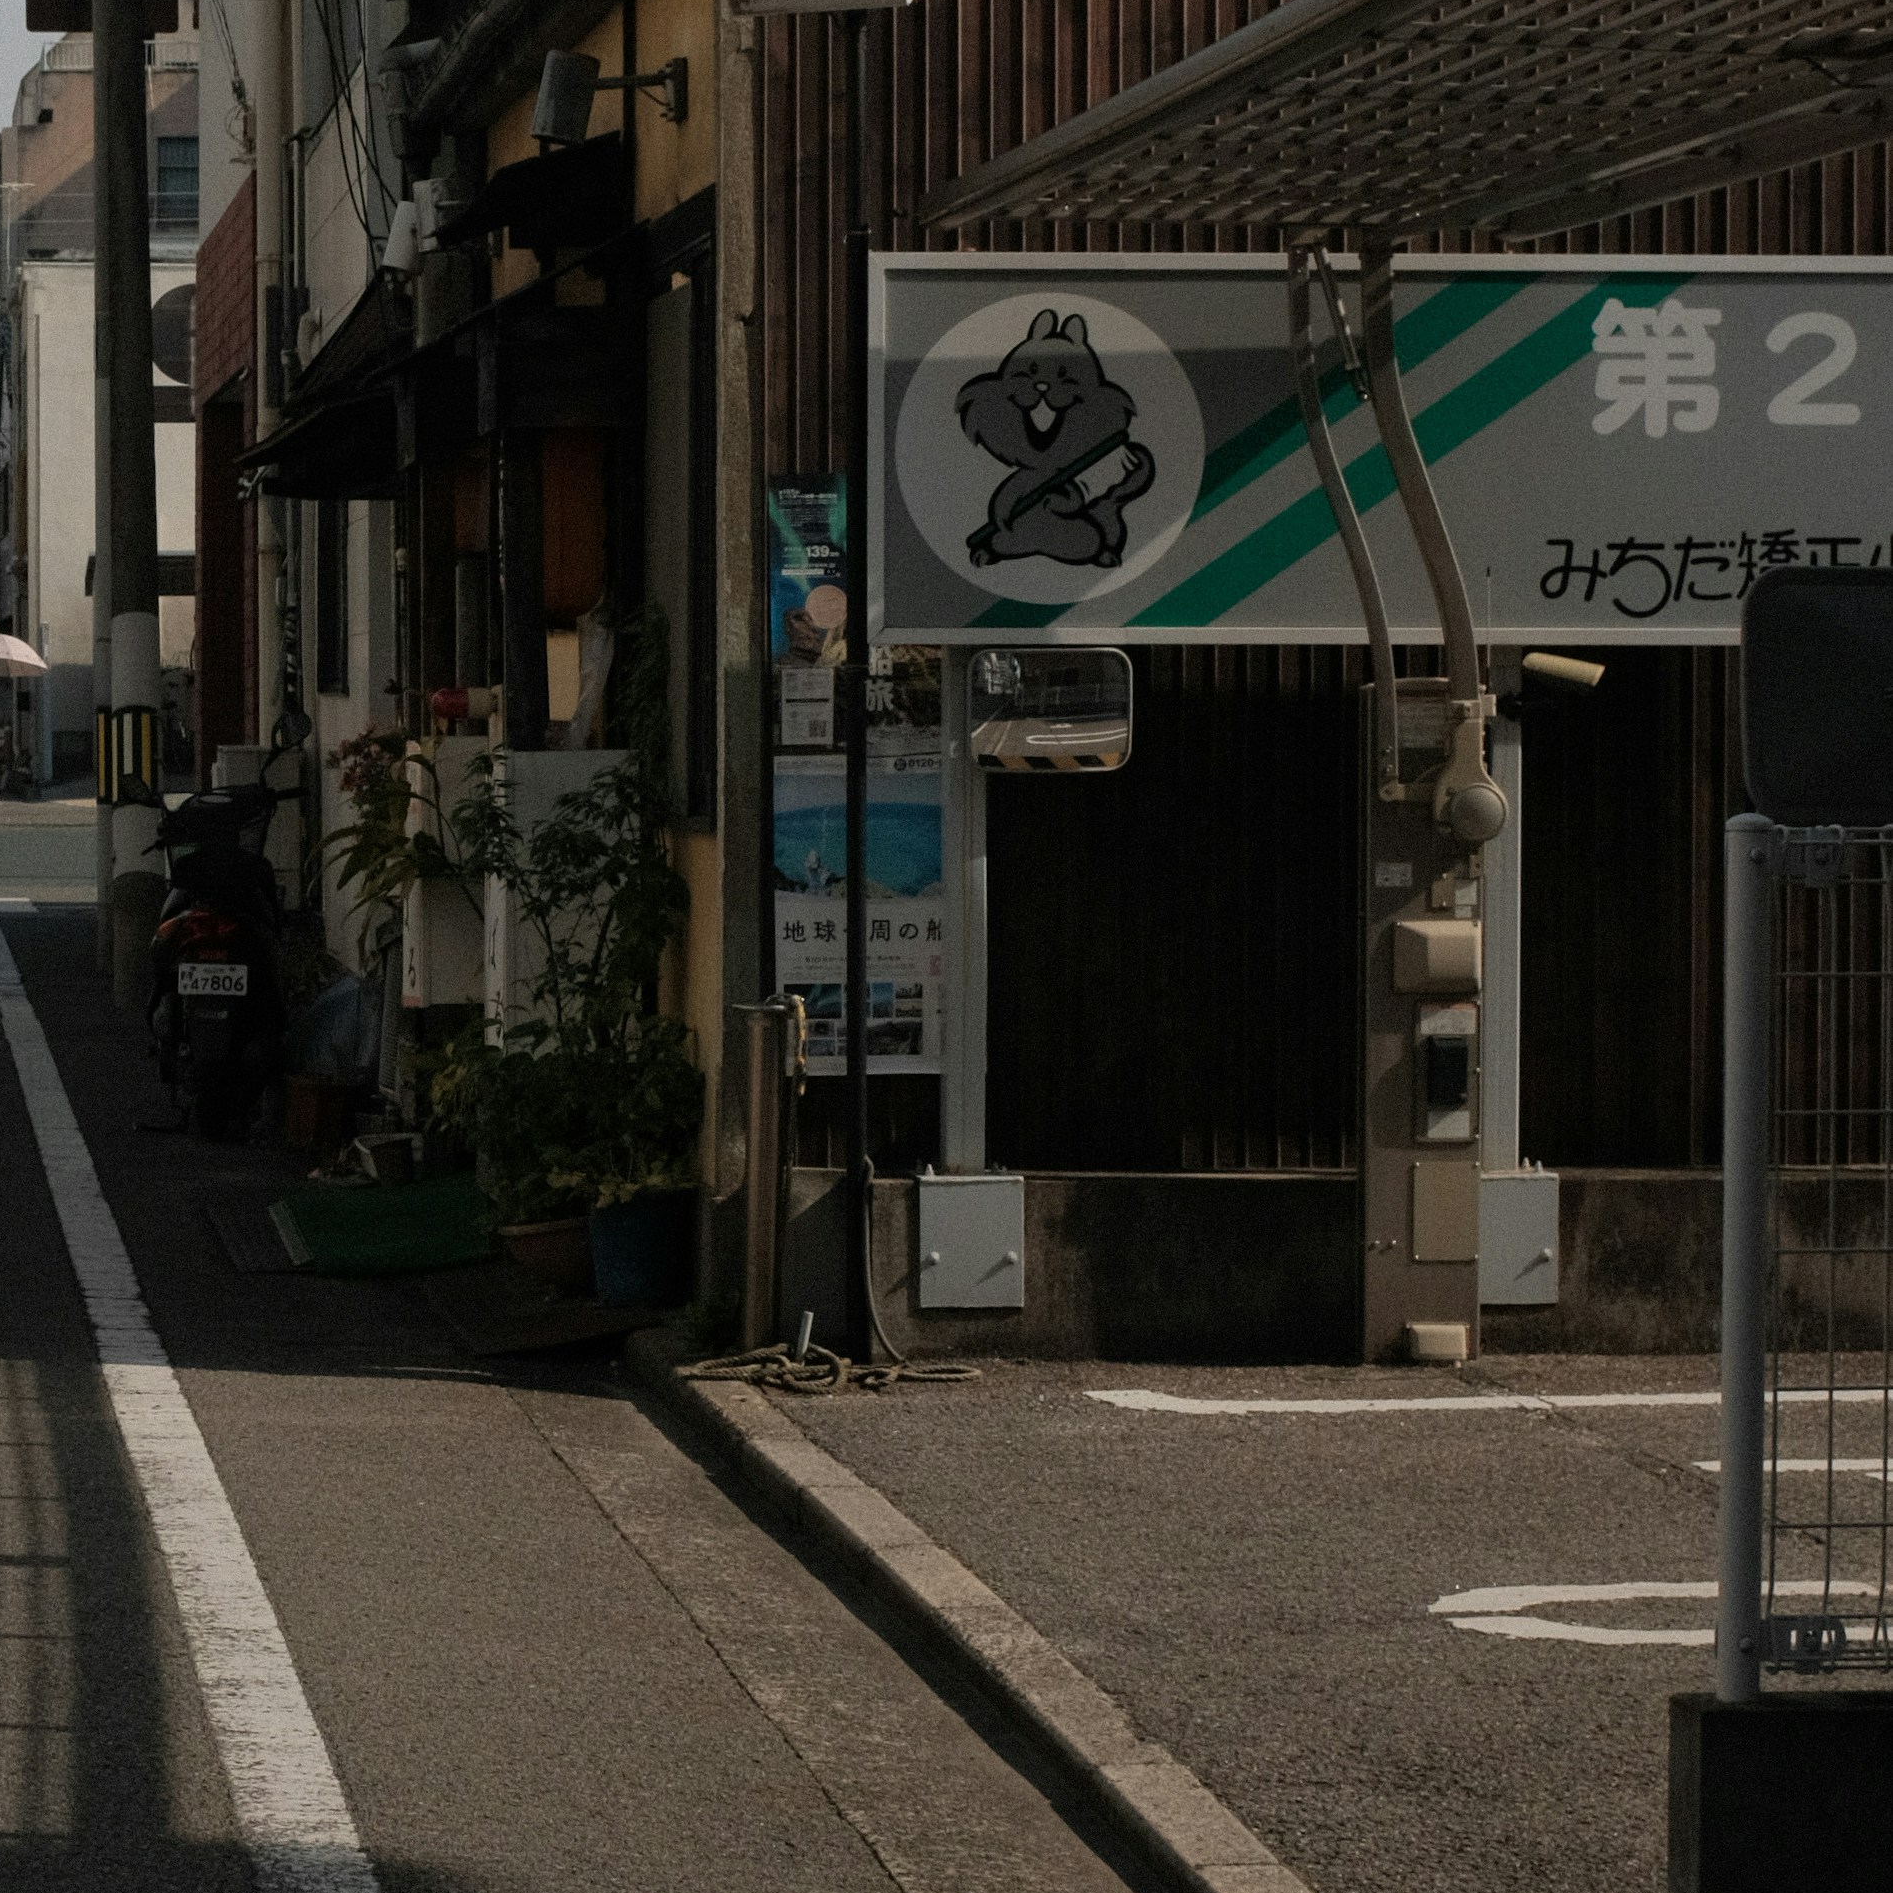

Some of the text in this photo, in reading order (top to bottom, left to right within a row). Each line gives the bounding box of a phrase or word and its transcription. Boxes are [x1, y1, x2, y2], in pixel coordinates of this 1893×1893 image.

[783, 919, 941, 943] 地球周の船
[191, 976, 244, 991] 47806
